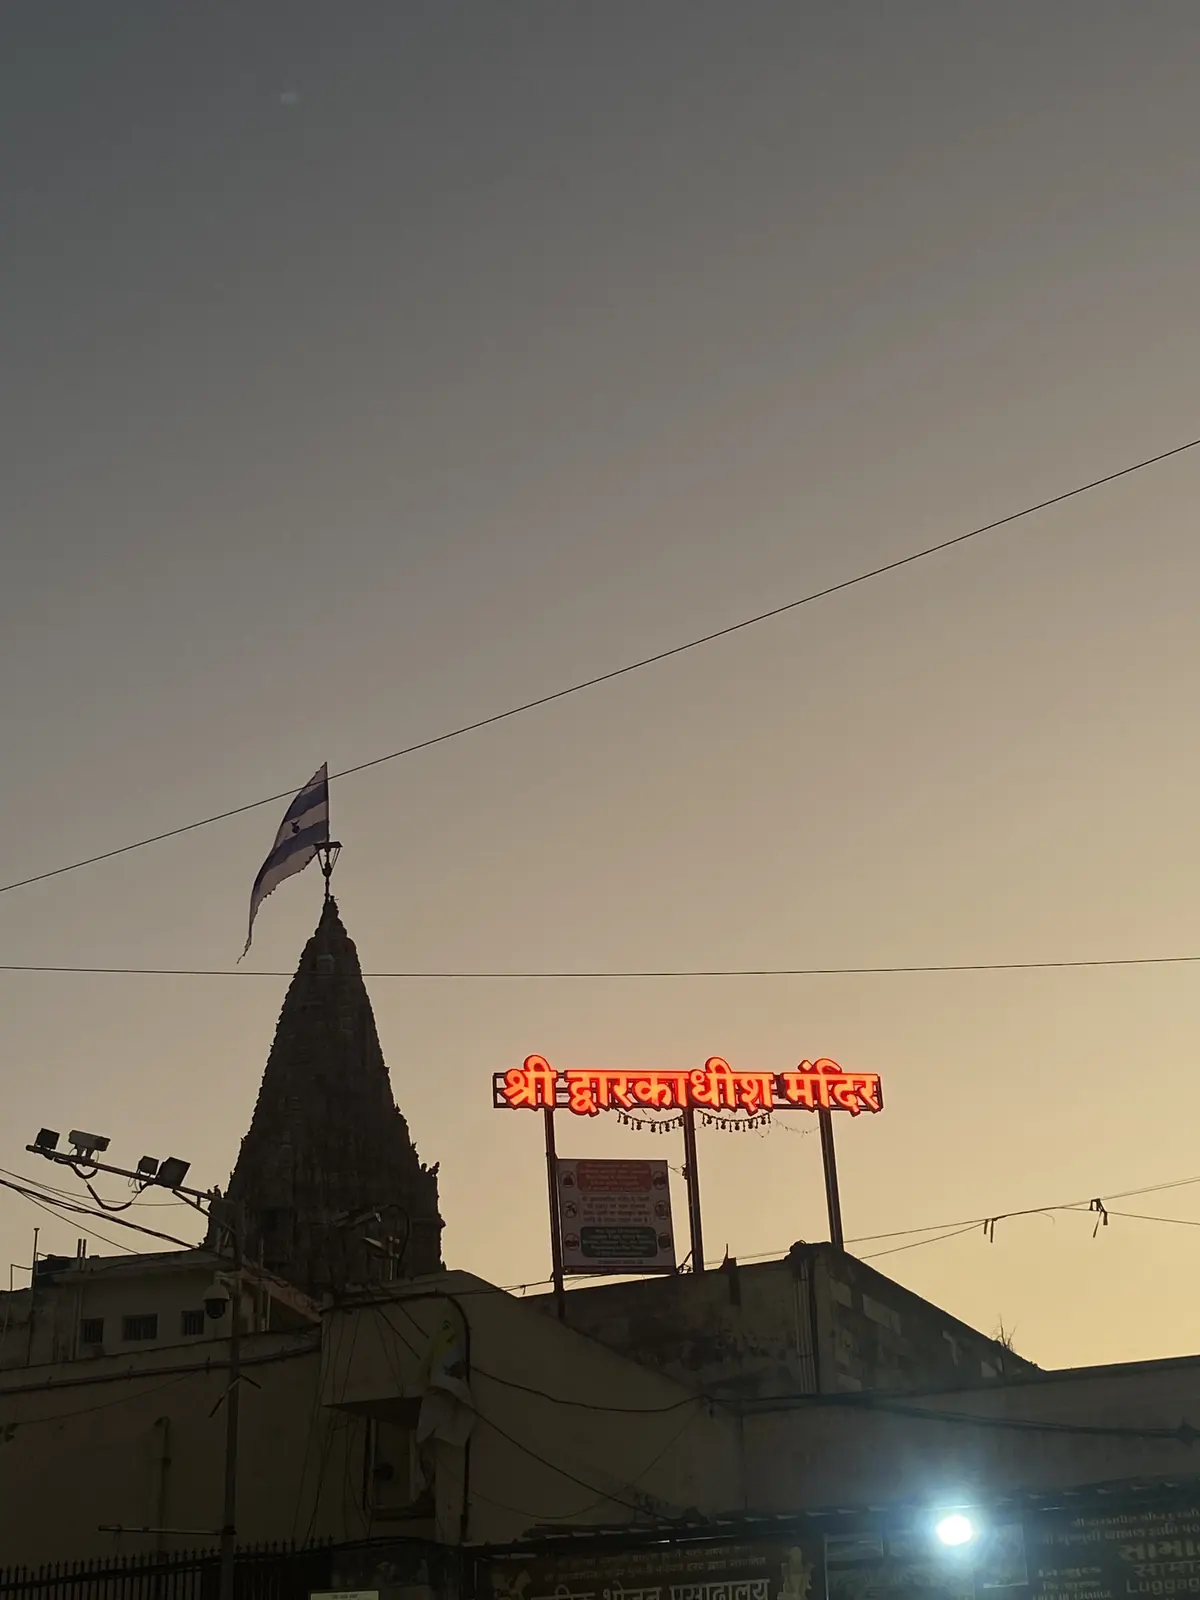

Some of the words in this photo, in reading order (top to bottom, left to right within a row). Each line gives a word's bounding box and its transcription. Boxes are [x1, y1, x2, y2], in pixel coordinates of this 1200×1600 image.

[502, 1054, 558, 1108] श्री
[564, 1056, 775, 1117] द्वारकाधीश
[780, 1057, 880, 1115] मंदिर
[1118, 1539, 1200, 1561] સામા
[1132, 1560, 1200, 1577] सामा
